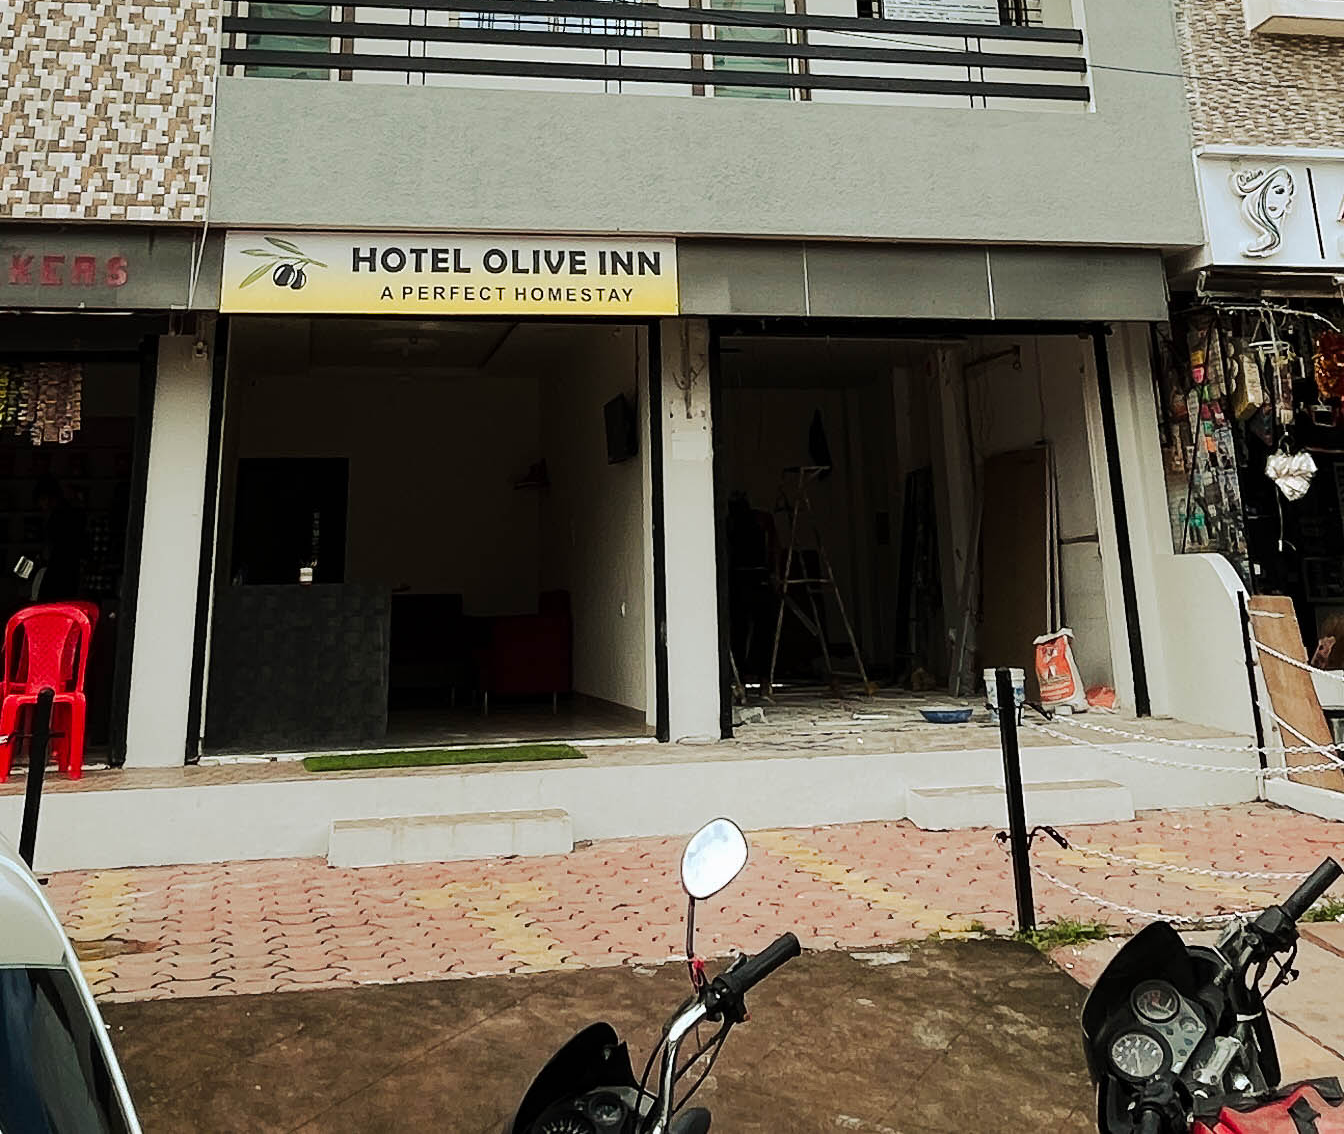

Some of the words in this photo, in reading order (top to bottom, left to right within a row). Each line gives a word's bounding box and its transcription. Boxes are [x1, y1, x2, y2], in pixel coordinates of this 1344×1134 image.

[352, 246, 471, 275] HOTEL
[482, 248, 589, 276] OLIVE
[598, 250, 661, 277] INN
[380, 286, 394, 300] A
[402, 286, 506, 302] PERFECT
[515, 287, 634, 303] HOMESTAY
